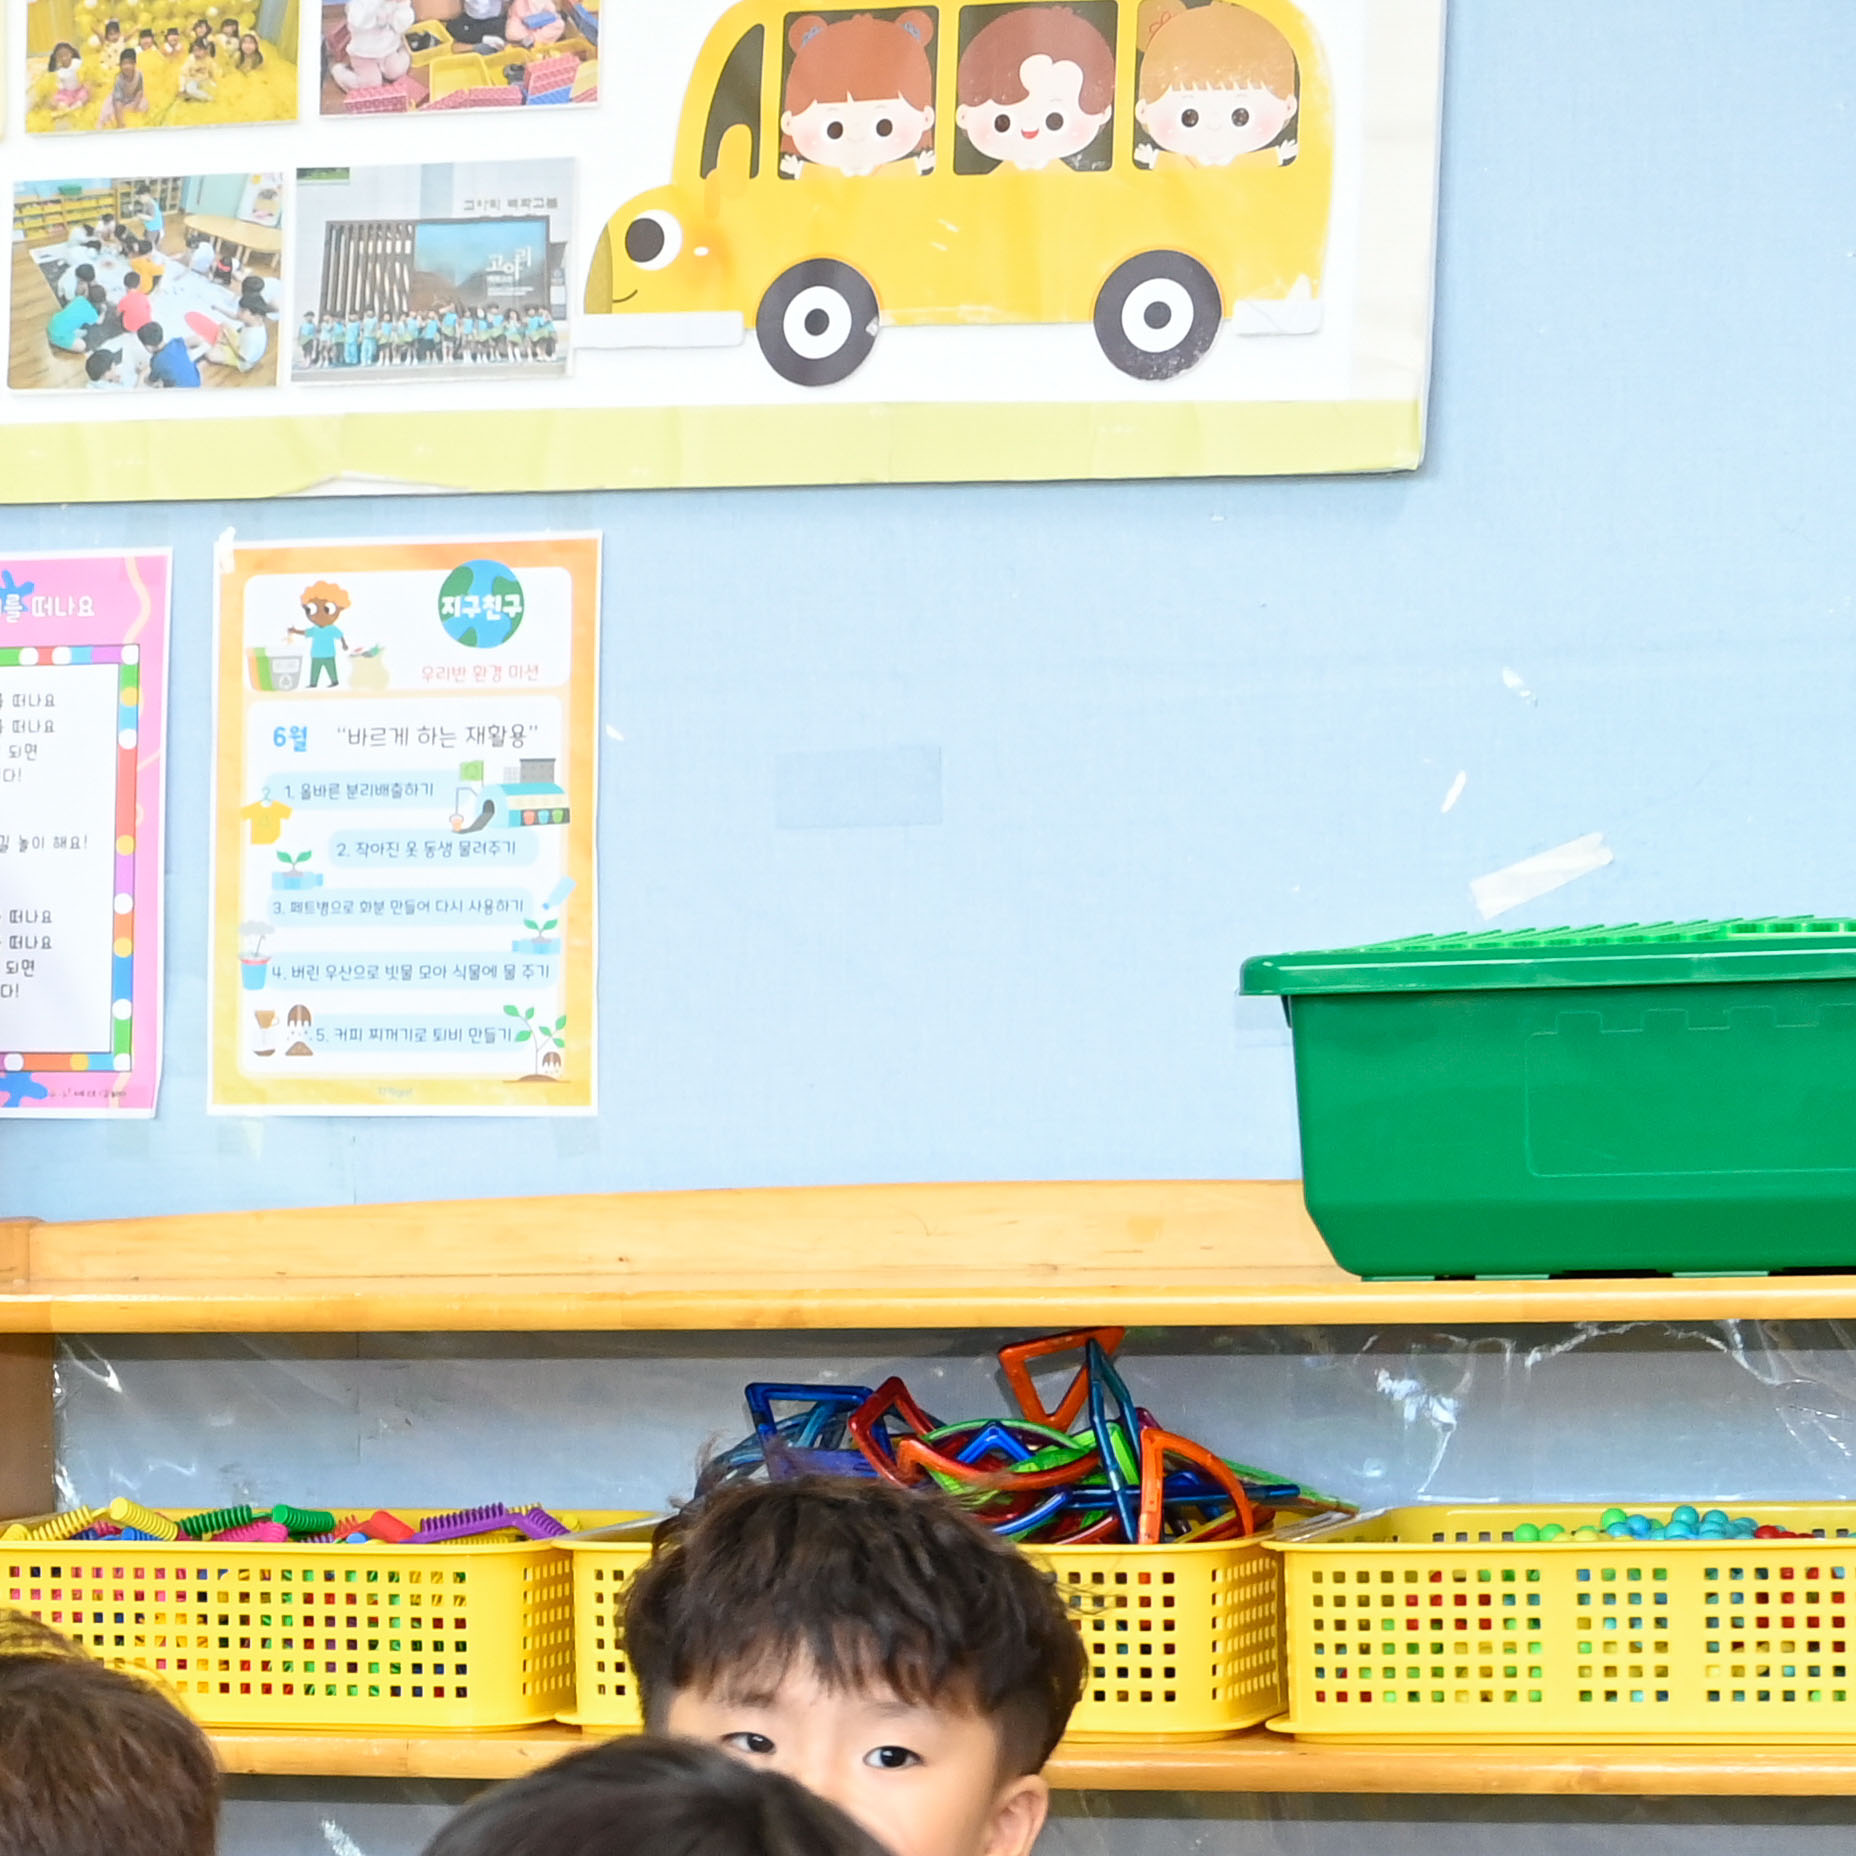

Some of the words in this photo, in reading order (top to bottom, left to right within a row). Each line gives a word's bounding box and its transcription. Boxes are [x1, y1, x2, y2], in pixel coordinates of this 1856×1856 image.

[32, 595, 95, 617] 떠나요
[441, 593, 523, 621] 지구친구
[422, 665, 467, 683] 우리반
[473, 664, 503, 682] 환경
[509, 664, 539, 681] 미션
[12, 694, 55, 708] 떠나요
[12, 720, 55, 734] 떠나요
[273, 726, 308, 752] 6월
[417, 726, 457, 748] 하는
[9, 743, 37, 761] 되면
[285, 785, 295, 798] 1.
[301, 783, 340, 800] 올바른
[347, 782, 434, 799] 분리배출하기
[19, 835, 44, 852] 놀이
[53, 833, 88, 850] 해요!
[336, 843, 351, 857] 2.
[356, 842, 399, 858] 작아진
[406, 841, 418, 857] 옷
[424, 841, 452, 857] 동생
[459, 841, 516, 857] 물려주기
[9, 909, 52, 924] 떠나요
[273, 901, 285, 914] 3.
[290, 900, 354, 916] 페트병으로
[360, 900, 385, 915] 화분
[390, 900, 430, 915] 만들어
[435, 900, 463, 913] 다시
[469, 899, 524, 915] 사용하기
[9, 935, 52, 949] 떠나요
[6, 959, 35, 977] 되면
[272, 966, 286, 980] 4.
[291, 965, 319, 981] 버린
[326, 965, 380, 981] 우산으로
[385, 964, 412, 981] 빗물
[419, 964, 446, 979] 모아
[453, 964, 498, 981] 식물에
[503, 964, 516, 981] 물
[522, 963, 550, 980] 주기
[316, 1028, 329, 1042] 5.
[335, 1028, 363, 1042] 커피
[368, 1028, 427, 1043] 찌꺼기로
[433, 1028, 462, 1042] 퇴비
[468, 1027, 512, 1043] 만들기
